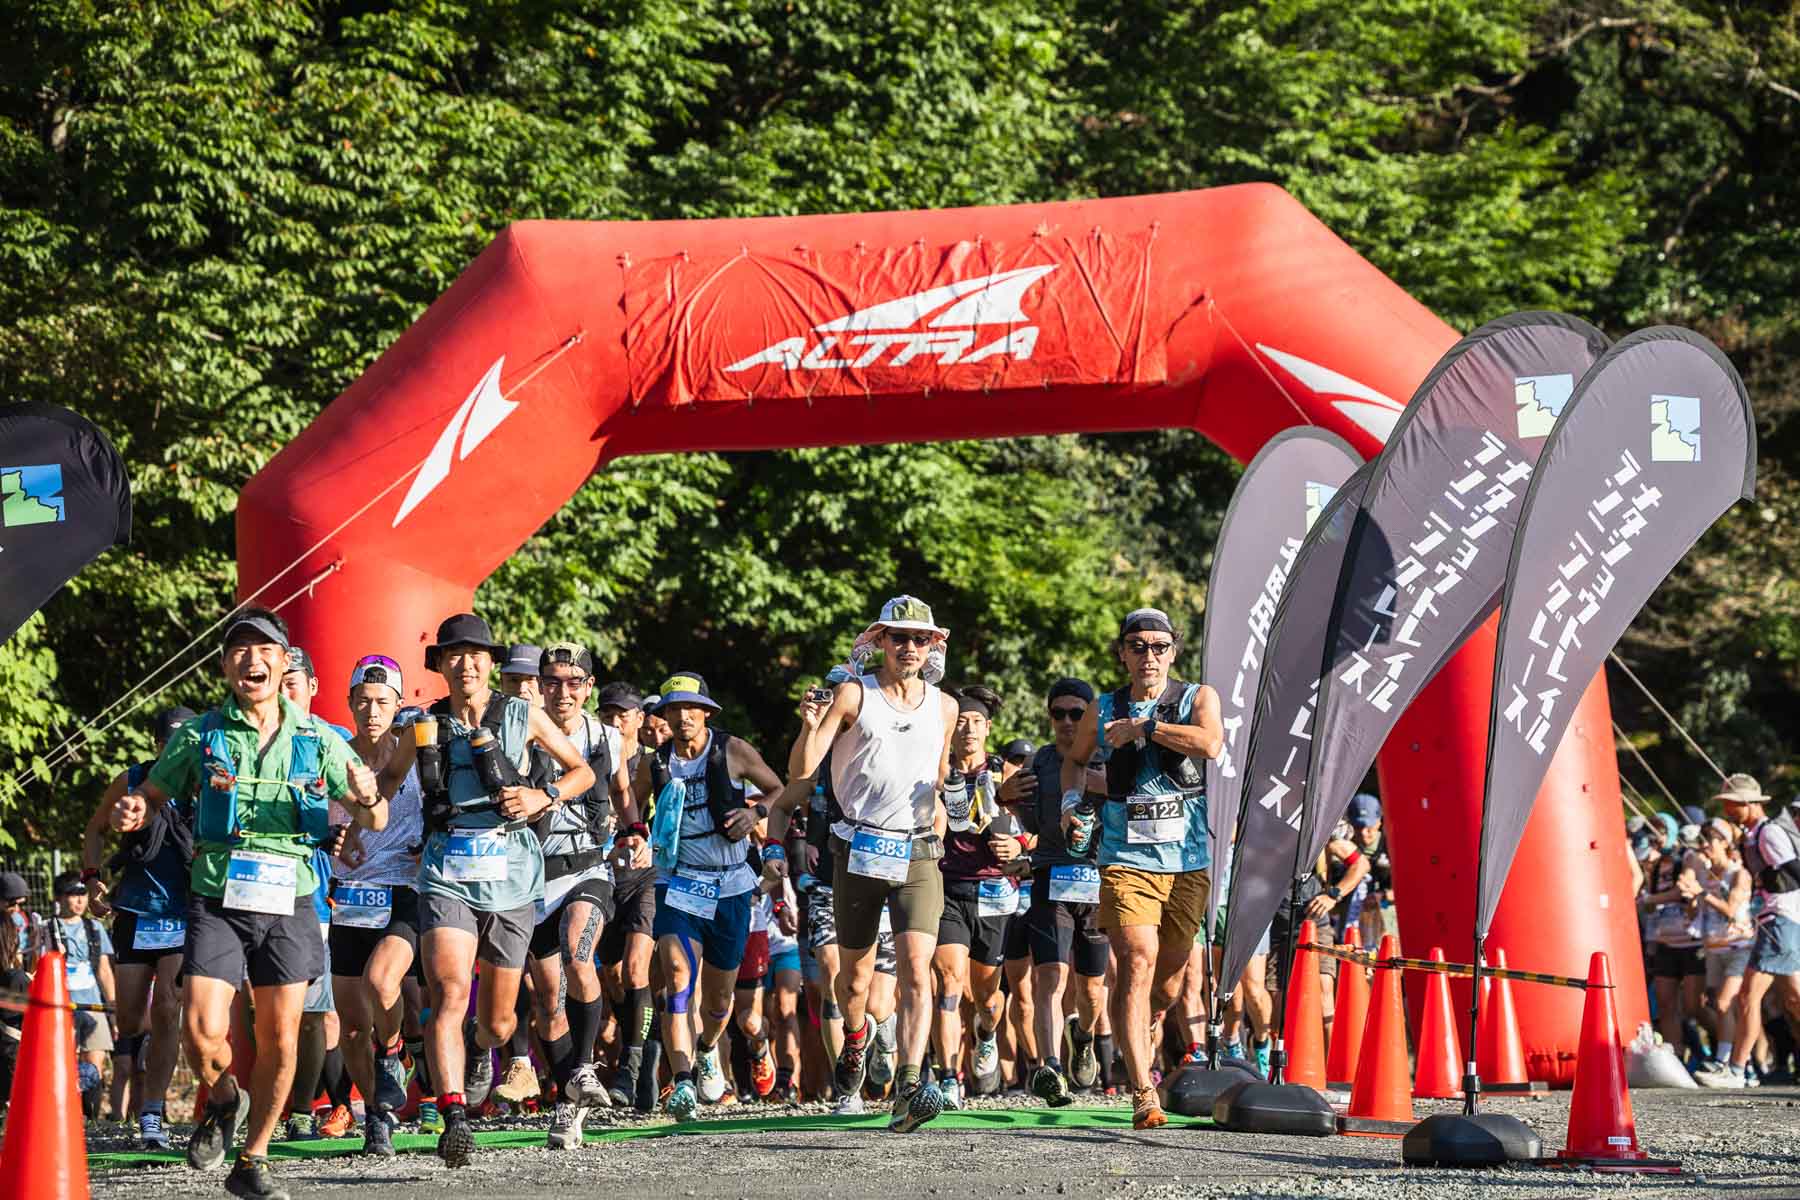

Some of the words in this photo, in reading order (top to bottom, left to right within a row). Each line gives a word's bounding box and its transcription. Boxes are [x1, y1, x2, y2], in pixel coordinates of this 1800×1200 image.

[724, 325, 1040, 372] ALTRA
[1149, 801, 1180, 819] 122
[874, 838, 907, 858] 383
[356, 890, 387, 906] 138
[689, 880, 717, 898] 236
[157, 918, 182, 931] 151
